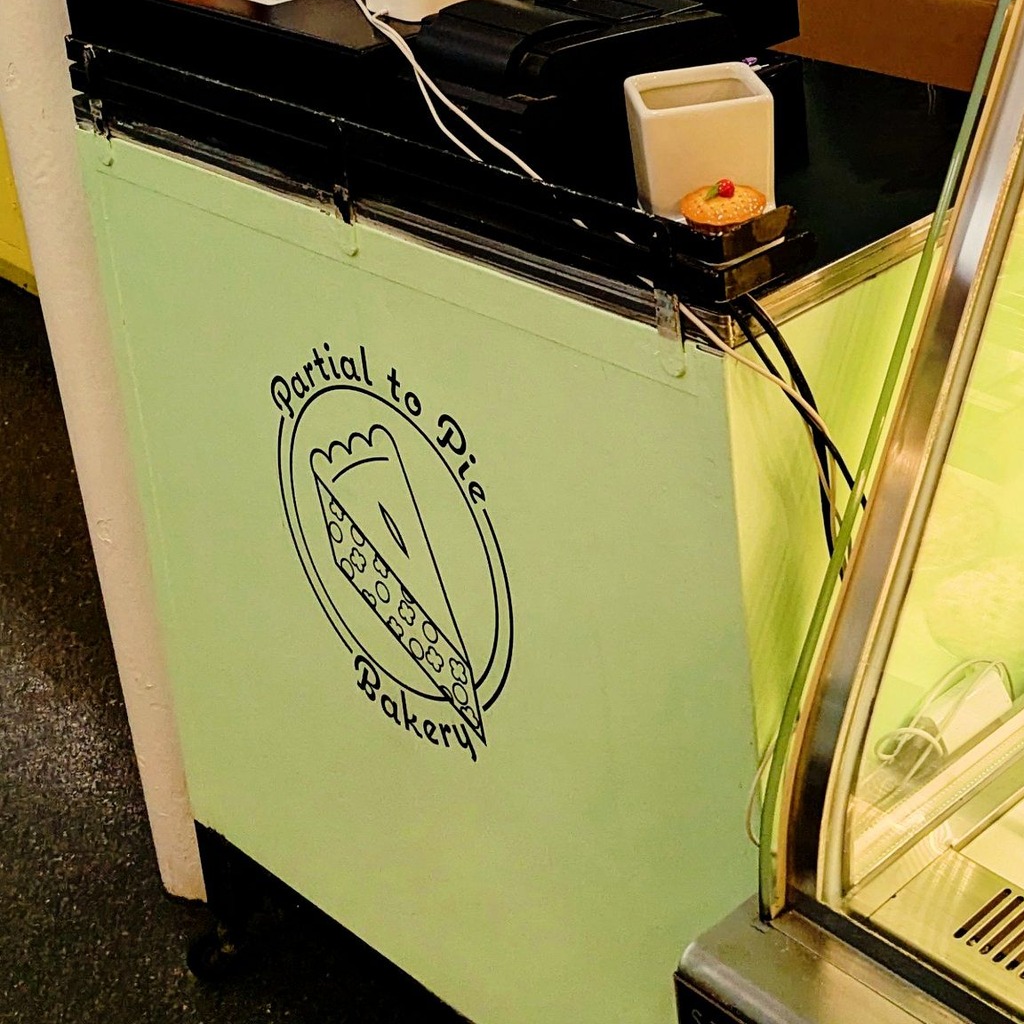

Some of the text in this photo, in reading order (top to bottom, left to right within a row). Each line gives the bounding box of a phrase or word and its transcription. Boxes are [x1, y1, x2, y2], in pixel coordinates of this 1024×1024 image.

[271, 342, 486, 506] Partial to Pie
[354, 654, 478, 763] Bakery
